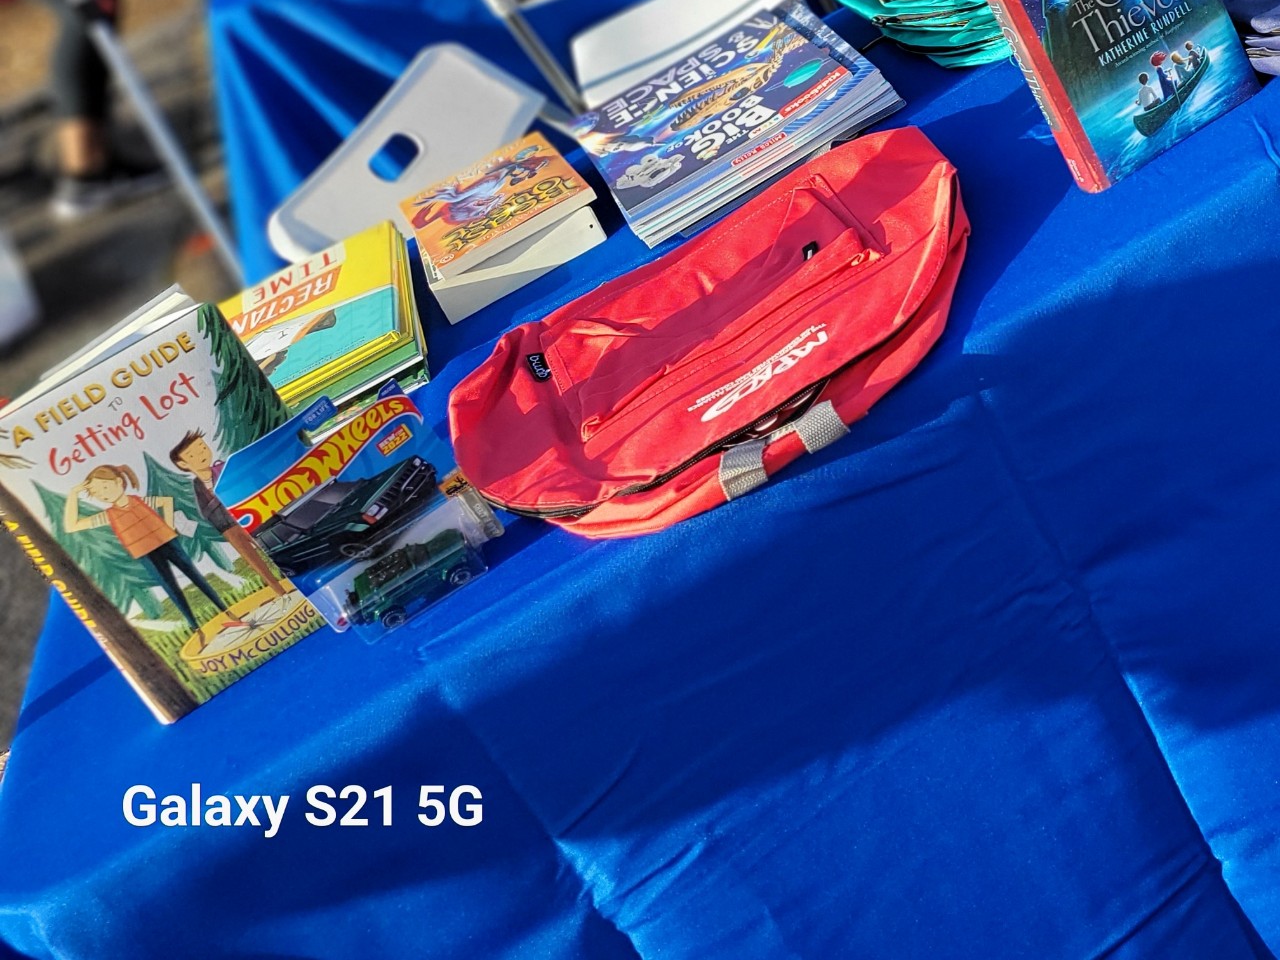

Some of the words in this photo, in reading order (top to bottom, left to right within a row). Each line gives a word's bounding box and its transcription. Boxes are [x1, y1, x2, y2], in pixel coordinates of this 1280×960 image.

[725, 29, 745, 45] &
[1097, 27, 1150, 66] KATHERINE
[1149, 0, 1192, 33] RUNDELL
[600, 43, 722, 116] SPACE
[782, 70, 841, 112] Kidsbooks
[664, 139, 683, 153] OF
[681, 91, 763, 146] BOOK
[687, 101, 777, 158] BIG
[724, 127, 748, 144] THE
[447, 179, 569, 253] Beast
[250, 251, 337, 305] TIME
[7, 420, 35, 449] A
[34, 378, 109, 433] FIELD
[108, 330, 196, 392] GUIDE
[107, 395, 124, 413] TO
[44, 404, 148, 479] Getting
[140, 368, 203, 422] Lost
[381, 432, 407, 454] 2022
[243, 464, 318, 521] HOT
[296, 398, 407, 481] WHEELS
[196, 653, 228, 675] JOY
[228, 603, 317, 667] McCULLOUG
